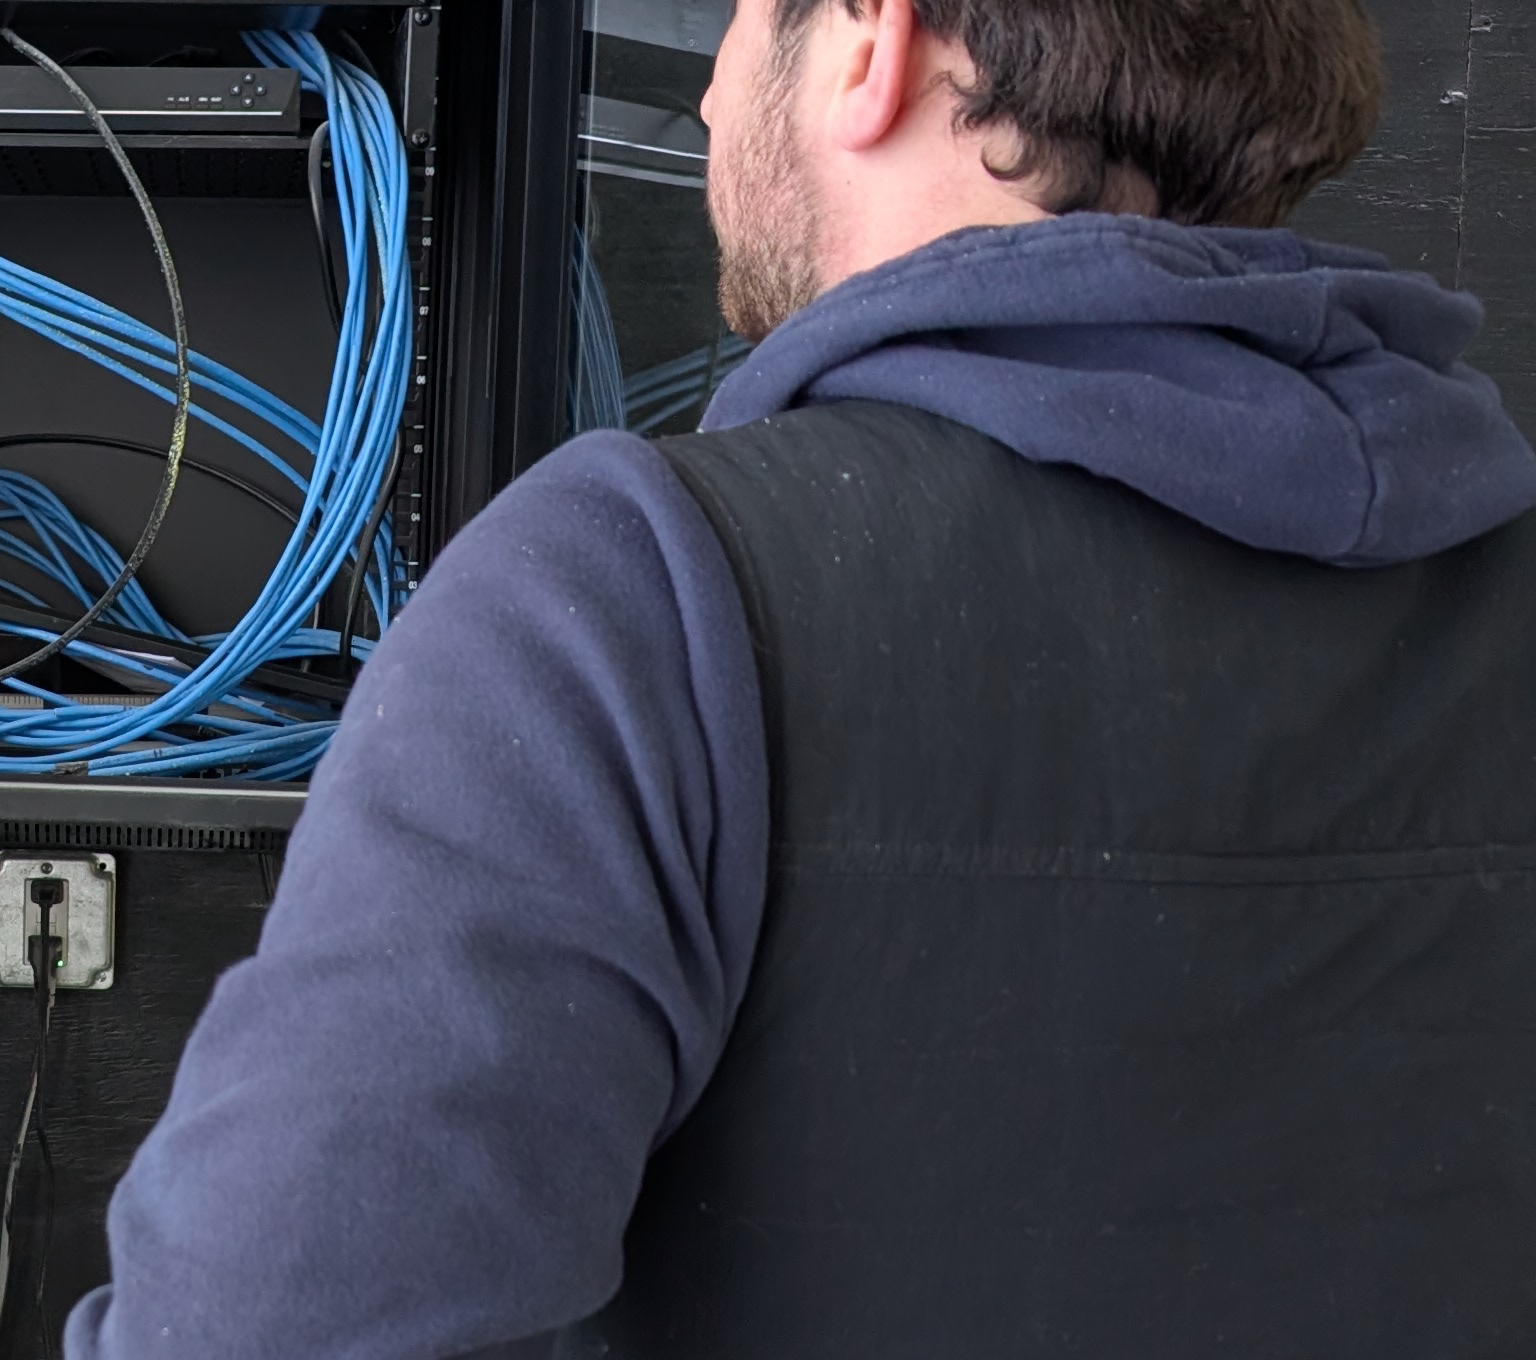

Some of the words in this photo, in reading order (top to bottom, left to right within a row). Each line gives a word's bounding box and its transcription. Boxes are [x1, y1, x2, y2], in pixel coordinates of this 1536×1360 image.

[424, 166, 435, 177] 09
[419, 305, 429, 315] 07
[410, 512, 421, 522] 04
[408, 580, 418, 590] 03
